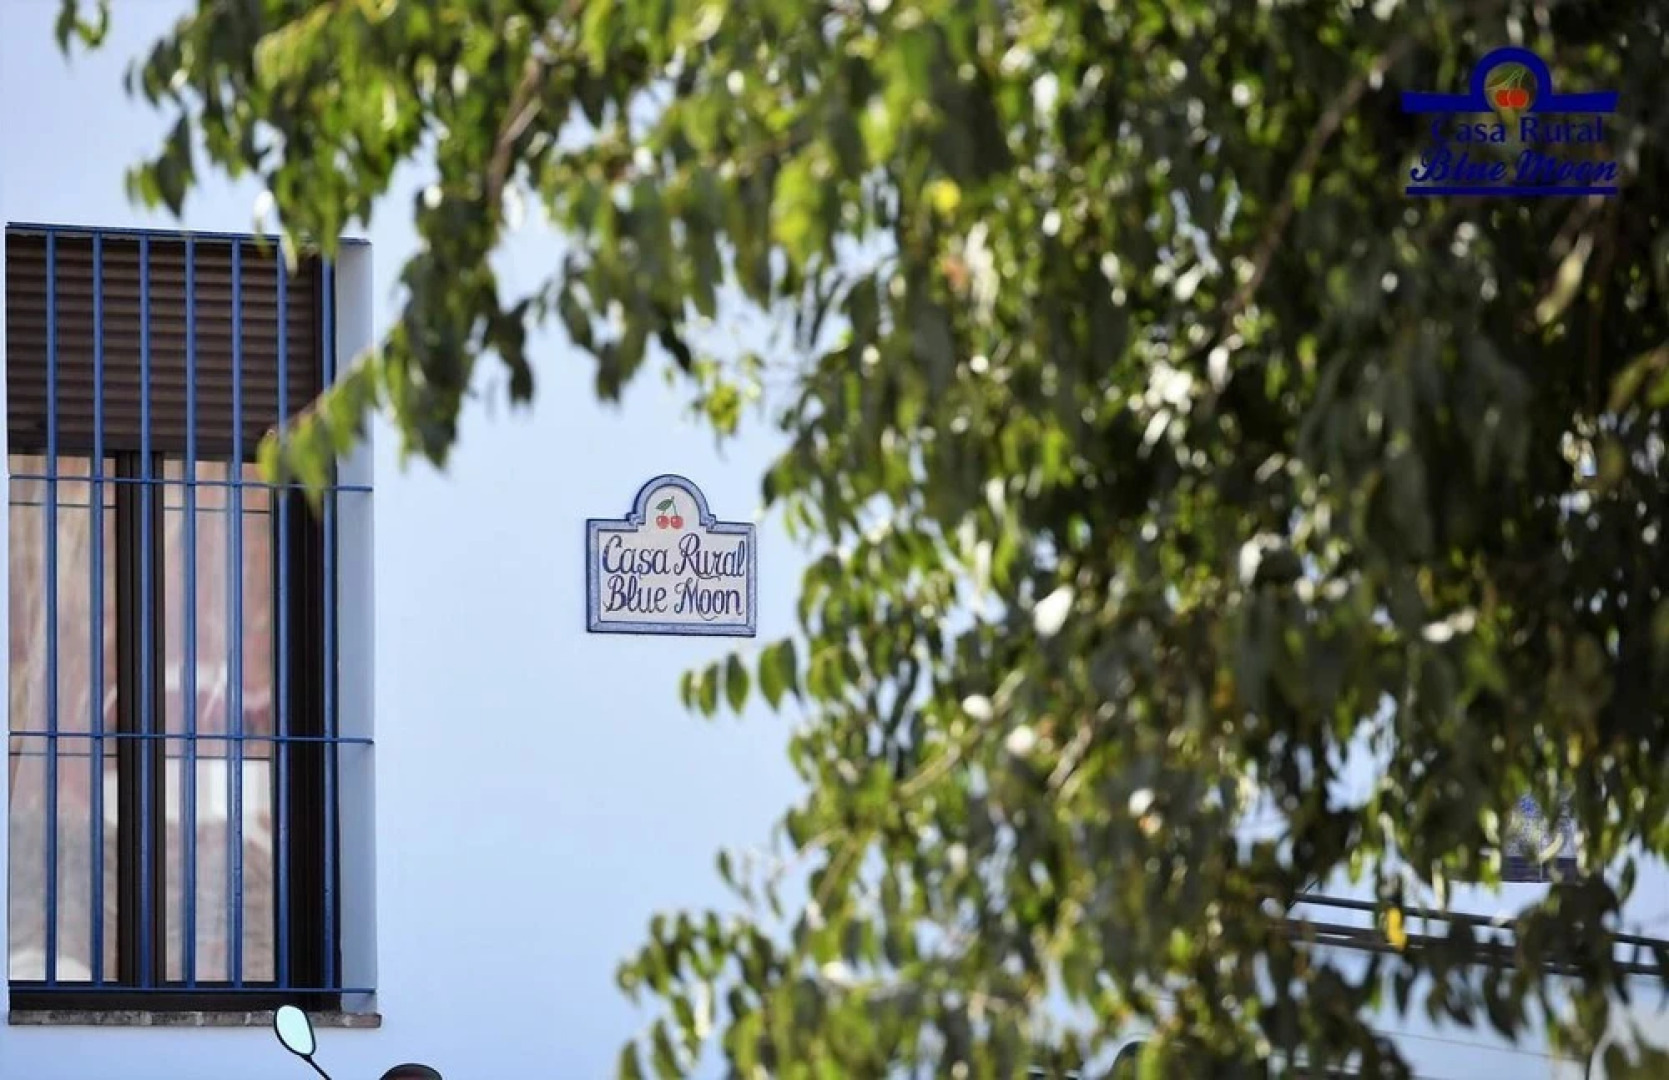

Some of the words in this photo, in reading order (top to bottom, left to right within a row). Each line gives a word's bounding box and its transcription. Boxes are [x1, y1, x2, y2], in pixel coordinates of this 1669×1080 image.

[602, 534, 671, 577] Casa
[674, 532, 745, 580] Rural
[603, 574, 668, 613] Blue
[674, 577, 744, 621] Moon
